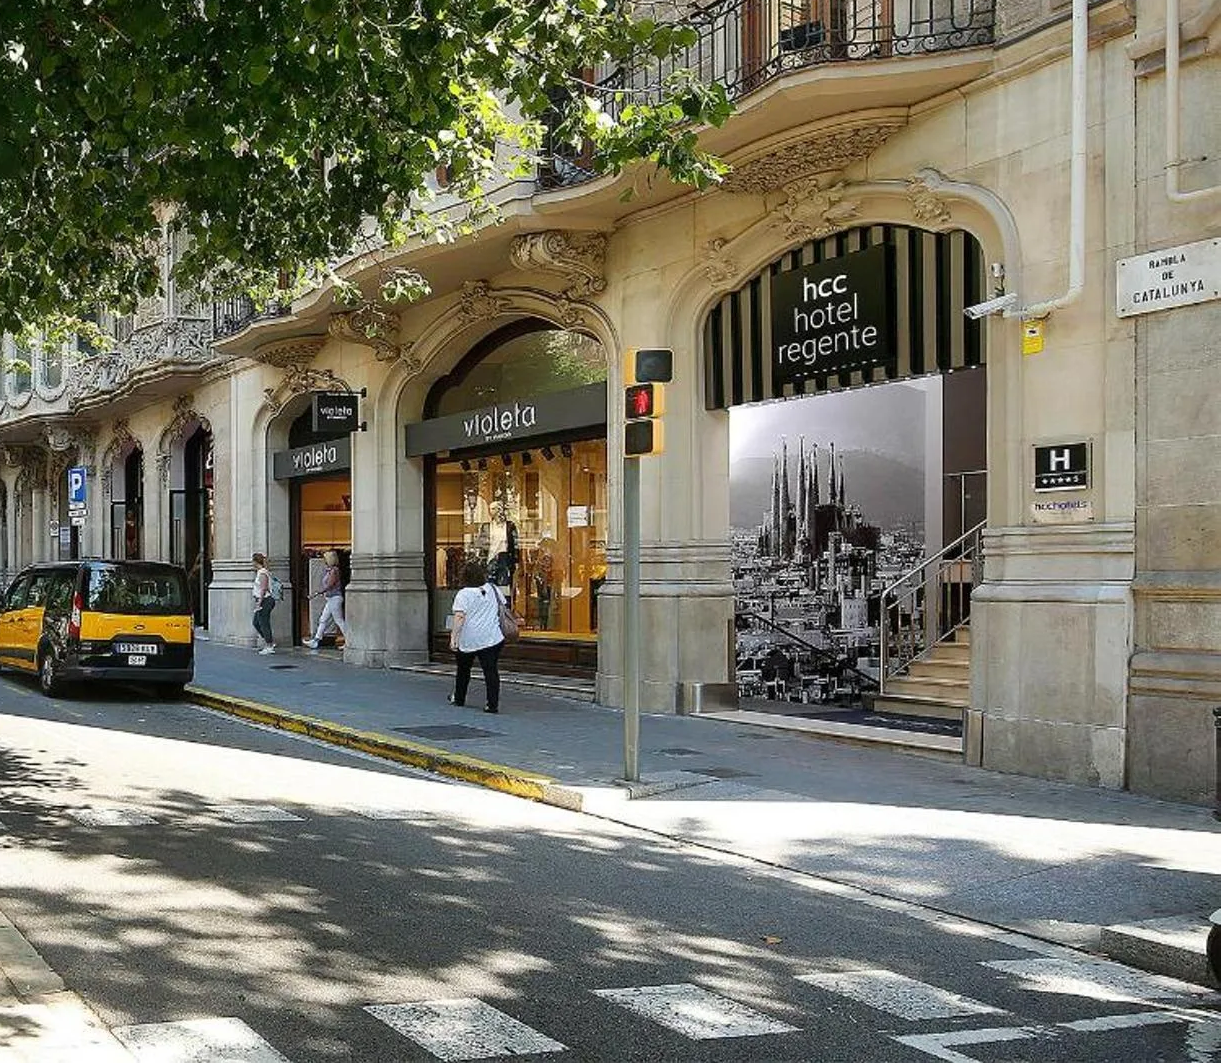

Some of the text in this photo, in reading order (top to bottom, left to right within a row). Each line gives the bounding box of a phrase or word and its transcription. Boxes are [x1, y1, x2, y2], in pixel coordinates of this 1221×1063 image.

[1148, 253, 1187, 269] RAMBLA
[803, 274, 848, 303] hcc
[1161, 270, 1175, 281] DE
[1132, 279, 1205, 304] CATALUNYA
[793, 292, 858, 334] hotel
[778, 325, 878, 366] regente
[320, 405, 353, 416] violeta
[463, 402, 537, 437] violeta
[292, 443, 337, 469] violeta
[1050, 449, 1070, 471] H
[71, 473, 82, 499] P
